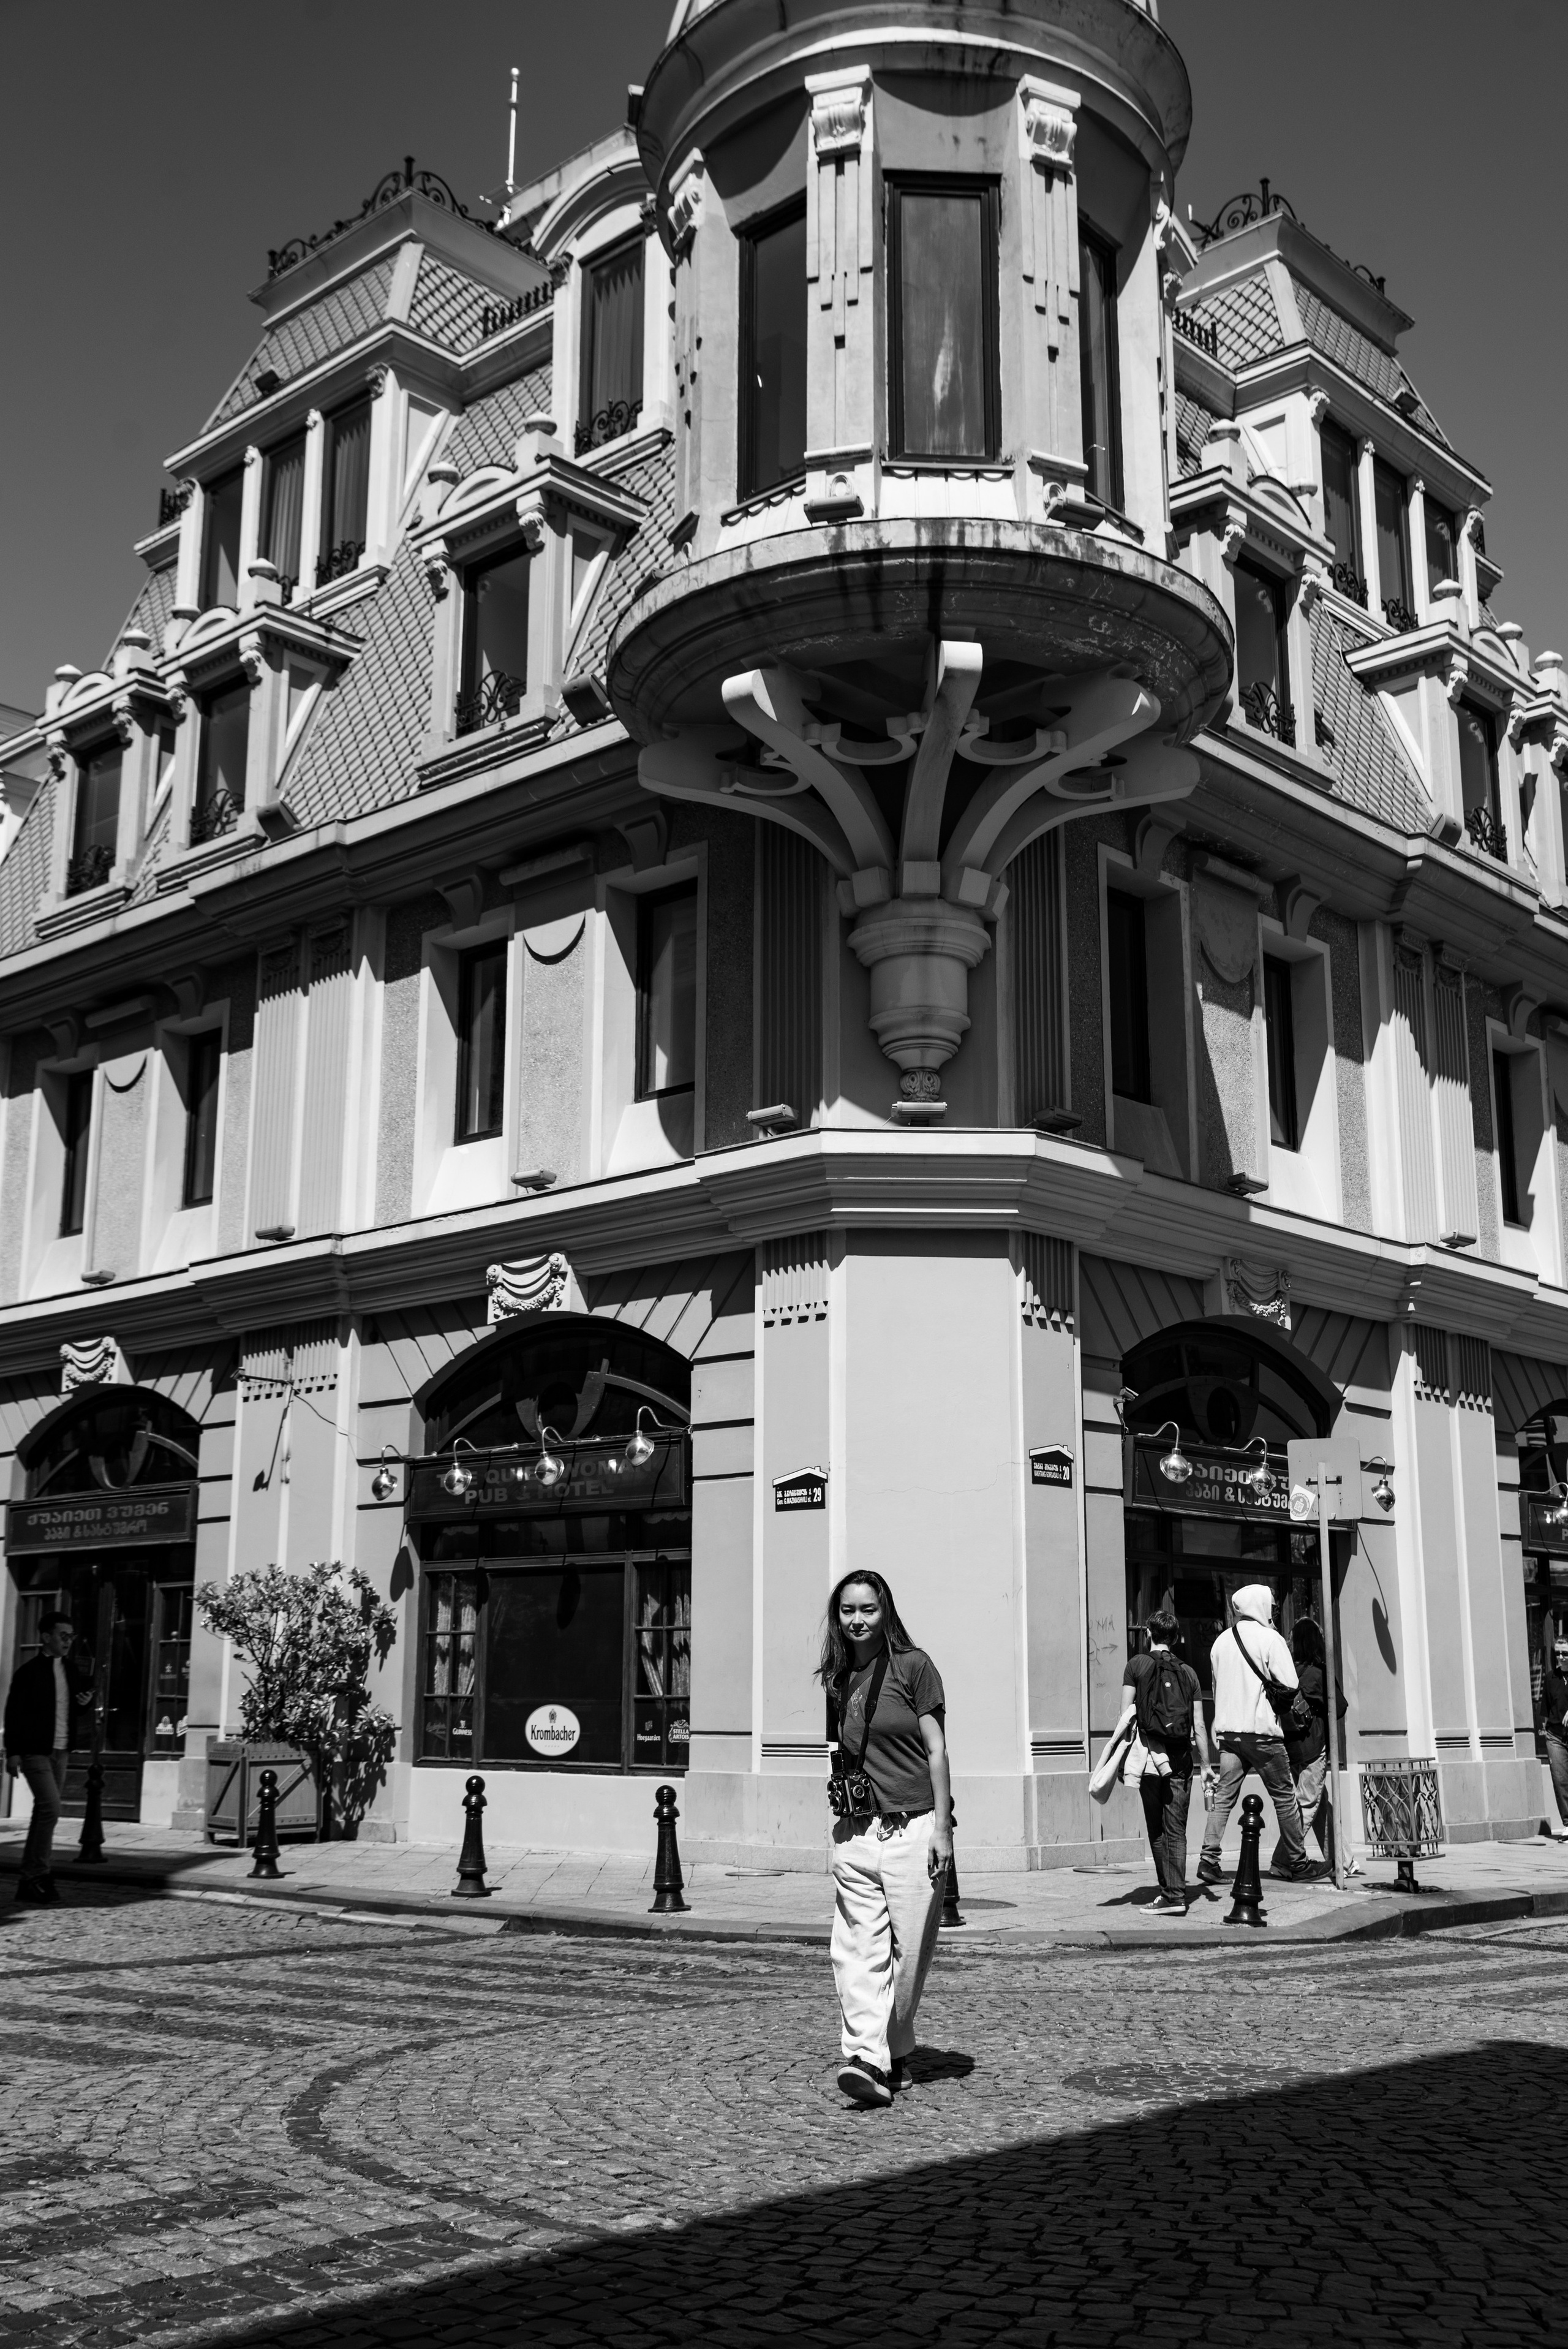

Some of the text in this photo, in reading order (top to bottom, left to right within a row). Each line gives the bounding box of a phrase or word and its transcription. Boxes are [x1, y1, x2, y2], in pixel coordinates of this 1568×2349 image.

[436, 1471, 478, 1488] TE
[485, 1466, 537, 1485] QUIE
[1063, 1466, 1069, 1480] 20
[465, 1488, 508, 1504] PUB
[538, 1480, 614, 1499] HOTEL
[813, 1487, 821, 1502] 29
[1224, 1486, 1235, 1502] &
[530, 1725, 576, 1741] Krombacher
[636, 1733, 661, 1742] Hoegaarden
